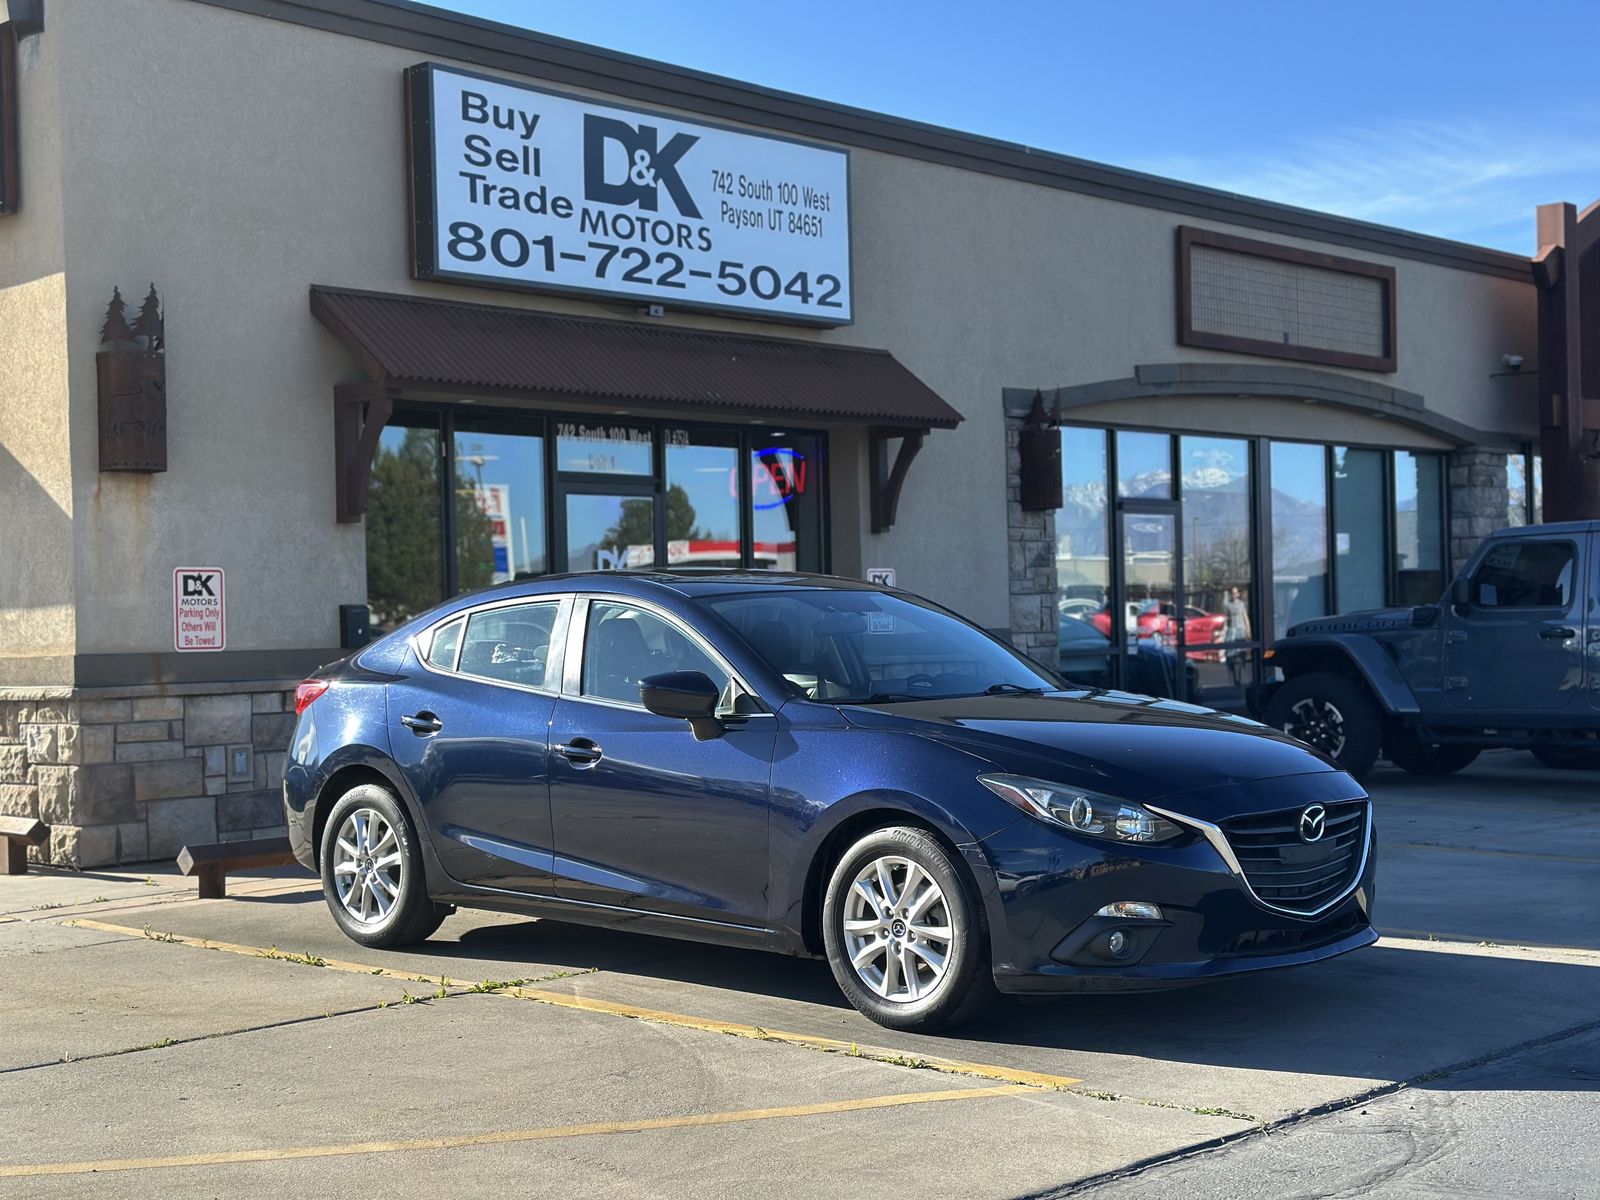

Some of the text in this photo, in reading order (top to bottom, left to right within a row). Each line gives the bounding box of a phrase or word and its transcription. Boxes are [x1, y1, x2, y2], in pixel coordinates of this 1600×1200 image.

[461, 90, 541, 140] Buy
[463, 134, 541, 177] Sell
[583, 113, 704, 220] D&K
[459, 171, 574, 219] Trade
[712, 170, 831, 212] 742 South 100 West
[579, 208, 713, 252] MOTORS
[721, 200, 823, 238] Payson UT 84651
[447, 221, 843, 308] 801-722-5042
[557, 423, 652, 446] 742 South 100 West
[179, 607, 220, 620] Parking Only
[181, 598, 218, 606] MOTORS
[181, 621, 217, 632] Others Will
[184, 635, 216, 646] Be Towed
